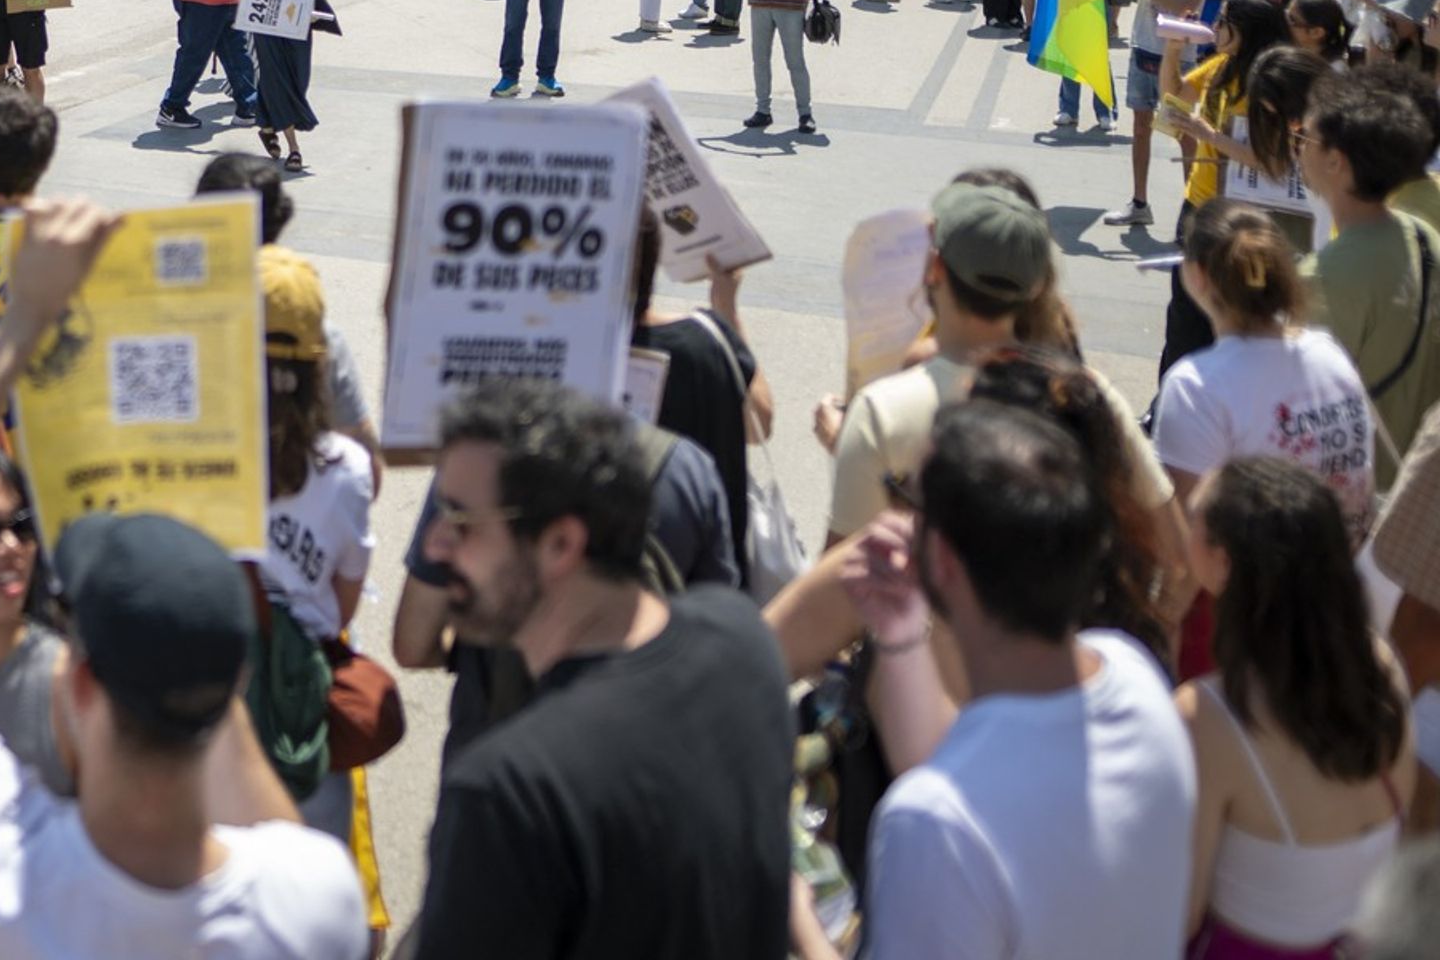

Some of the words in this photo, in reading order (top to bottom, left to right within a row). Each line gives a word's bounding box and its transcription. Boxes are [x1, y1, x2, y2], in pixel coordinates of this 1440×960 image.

[482, 170, 582, 198] PERDIDO
[443, 200, 604, 262] 90%
[431, 261, 463, 289] DE
[473, 261, 521, 290] SUS
[526, 262, 601, 293] PECES
